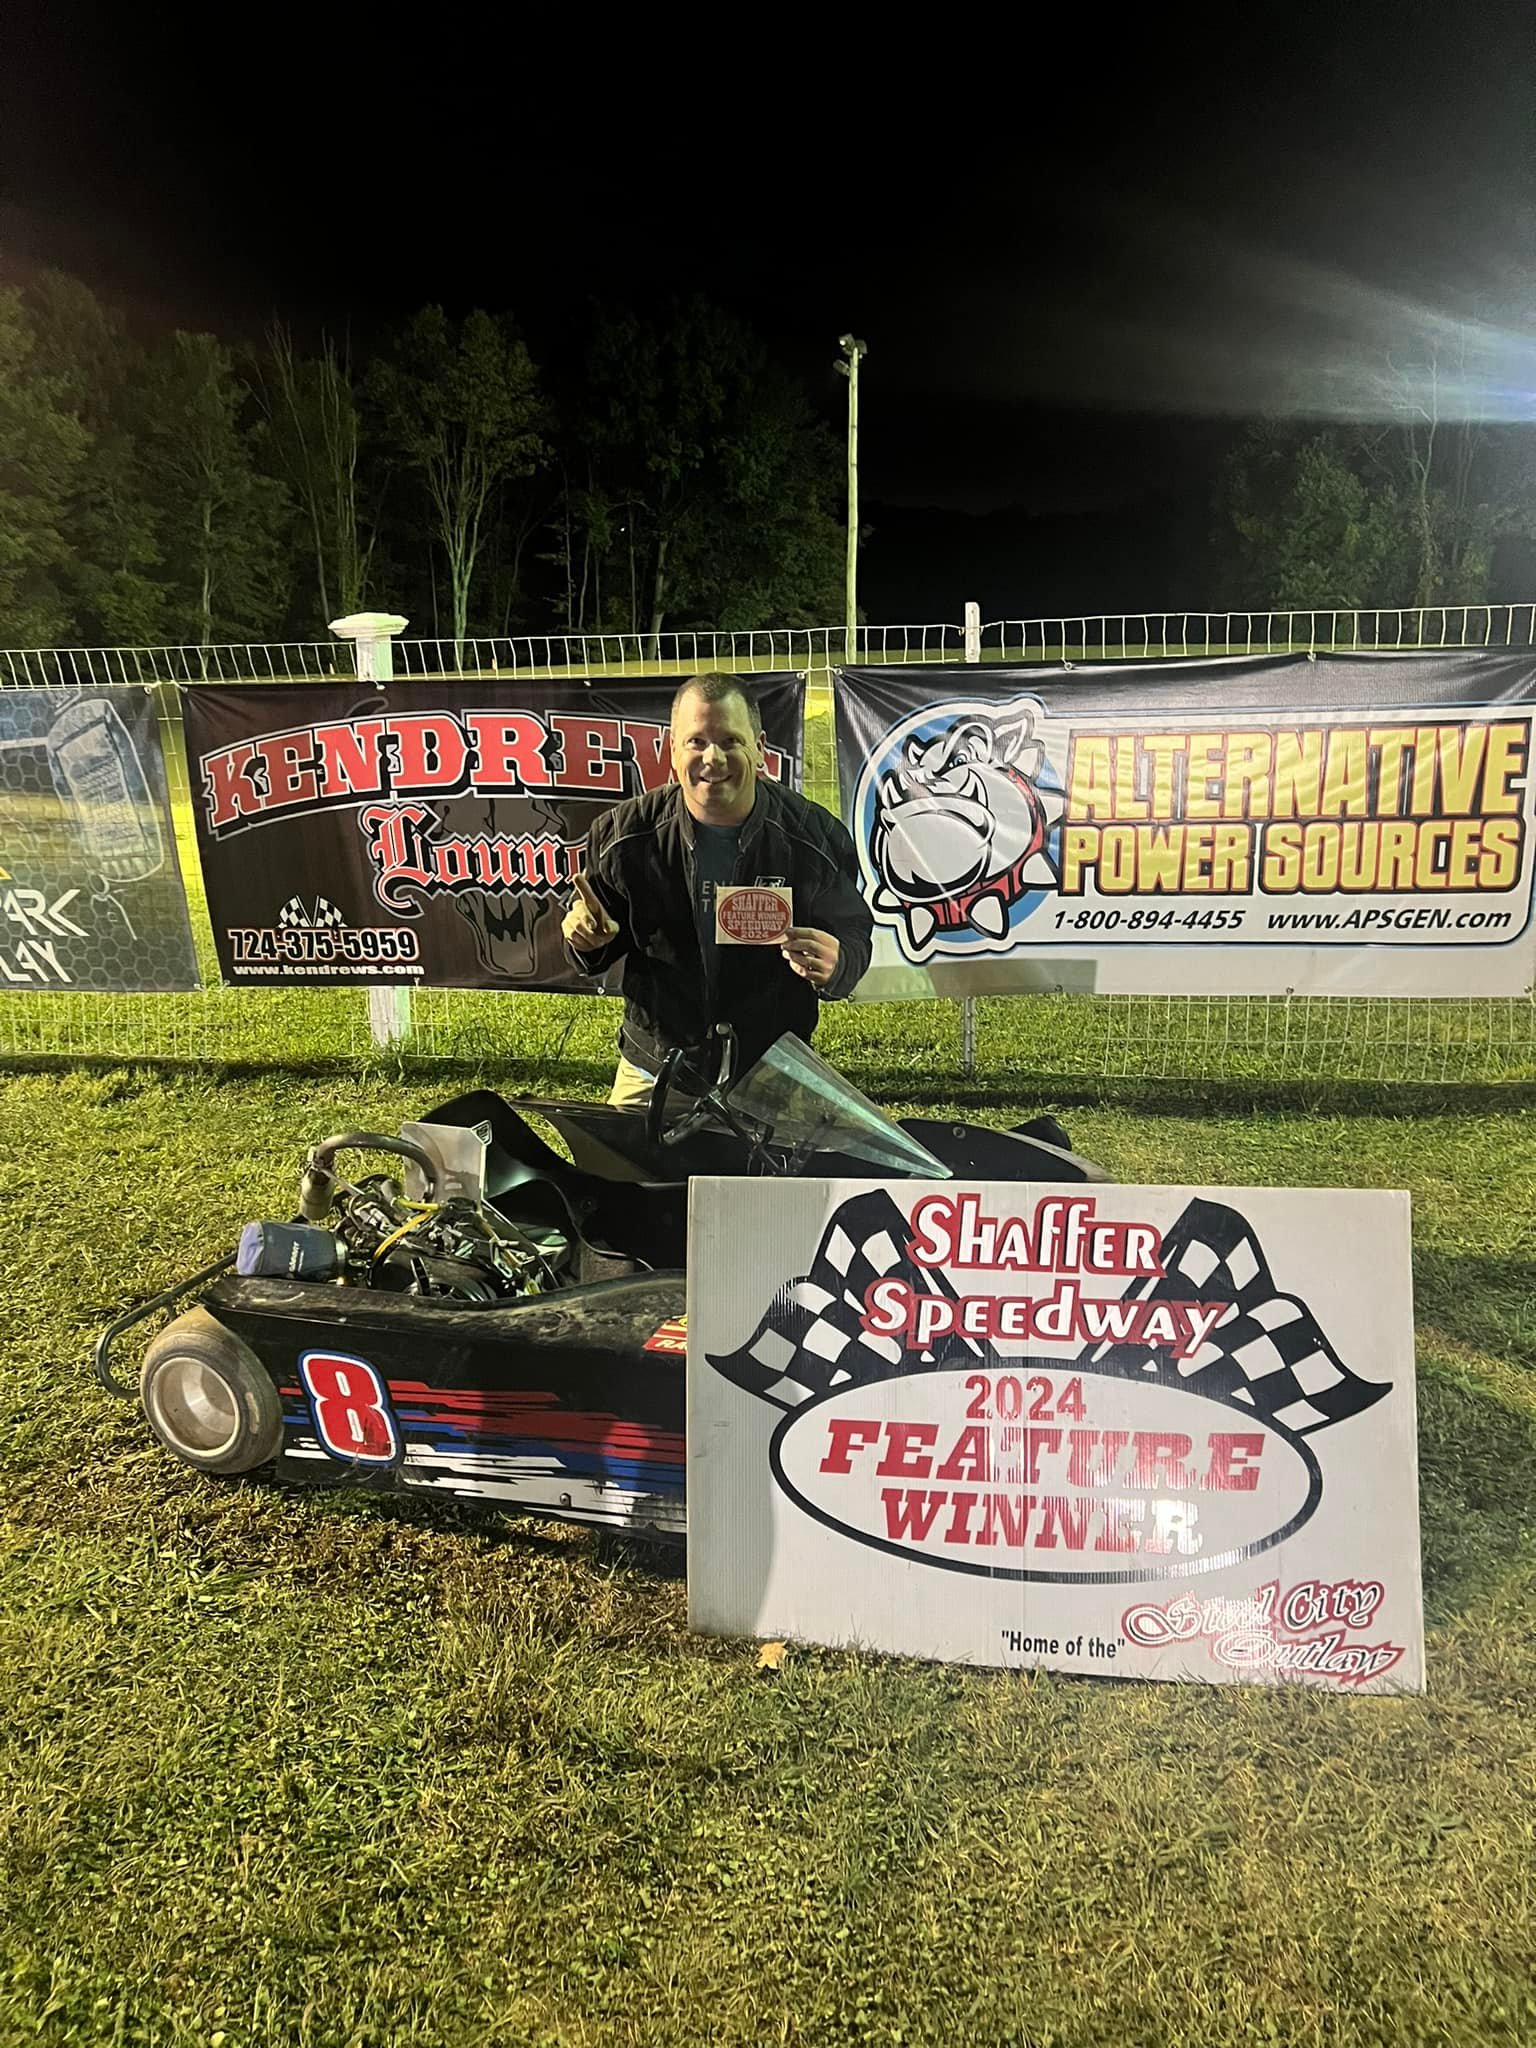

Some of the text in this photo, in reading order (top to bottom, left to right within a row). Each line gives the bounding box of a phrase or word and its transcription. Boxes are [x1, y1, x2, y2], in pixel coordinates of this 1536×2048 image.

[203, 708, 783, 824] KENDREW
[1068, 722, 1528, 820] ALTERNATIVE
[1061, 818, 1523, 894] POWER SOURCES
[727, 920, 783, 931] SPEEDWAY
[731, 893, 778, 911] SHAFFER
[1054, 908, 1512, 930] 1-800-894-4455 www.APSGEN.com
[228, 929, 420, 961] 724-375-5959
[233, 965, 425, 975] www.kendrews.com
[299, 1351, 397, 1462] 8
[964, 1374, 1087, 1422] 2024
[819, 1418, 1266, 1492] FEATURE
[880, 1487, 1203, 1555] WINNER
[1280, 1579, 1385, 1634] City
[1001, 1629, 1125, 1658] "Home of the"
[1208, 1629, 1404, 1684] Outlaw
